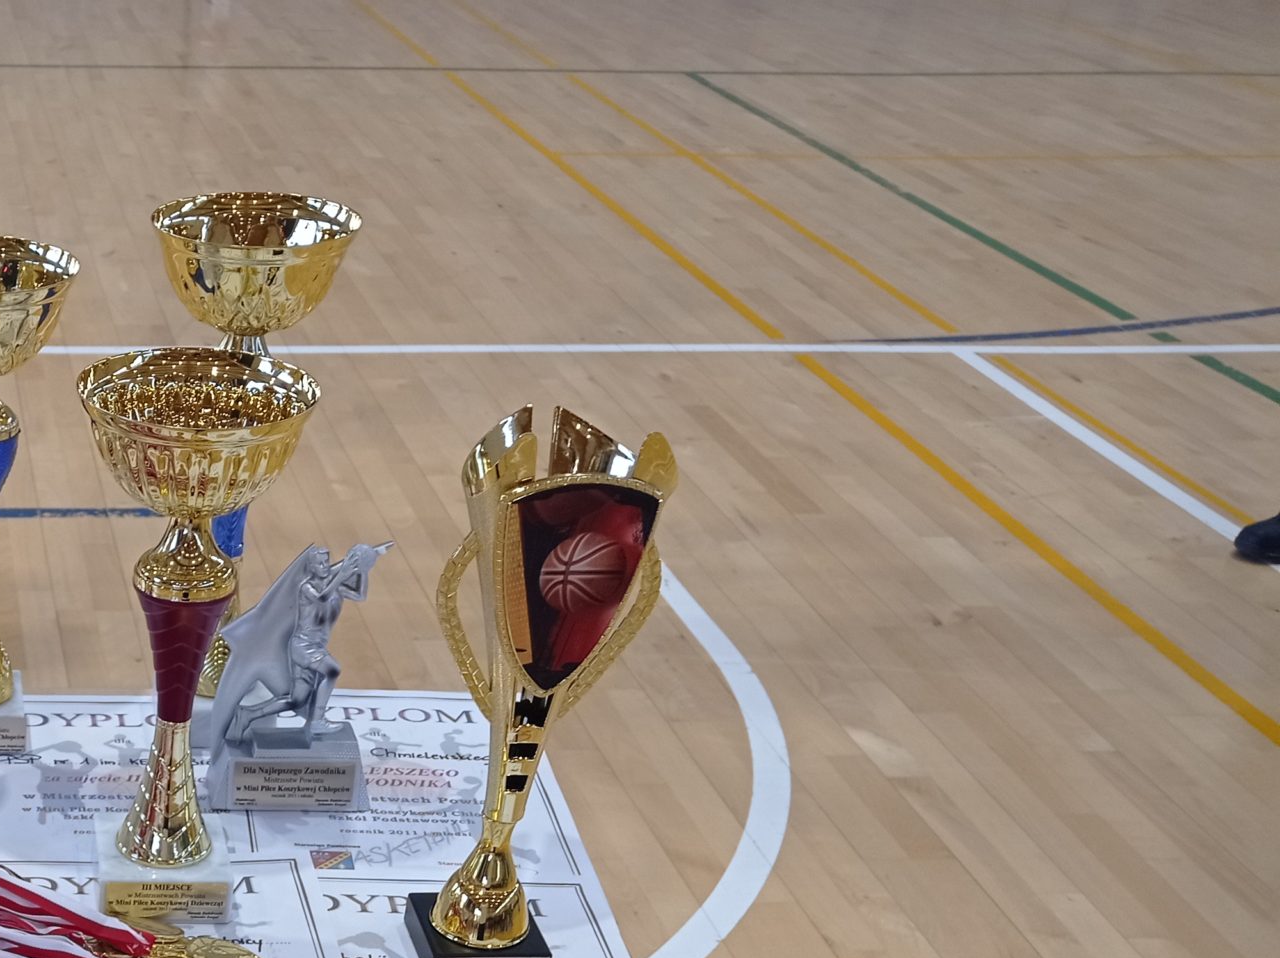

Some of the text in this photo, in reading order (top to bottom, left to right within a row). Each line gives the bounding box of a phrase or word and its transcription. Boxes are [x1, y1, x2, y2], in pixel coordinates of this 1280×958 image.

[330, 706, 477, 724] PLOM
[24, 712, 157, 728] DYPL
[129, 758, 149, 766] KE
[259, 767, 303, 776] Najlepszego
[304, 767, 346, 775] Zawodnika
[366, 766, 460, 777] EPSZEGO
[126, 774, 143, 783] II
[277, 785, 317, 794] Koszykowej
[41, 792, 137, 800] Mistrzostw
[436, 796, 484, 805] Powi
[372, 816, 476, 825] Podstawowych
[154, 883, 193, 891] MIEJSCE
[150, 900, 190, 908] Koszykowej
